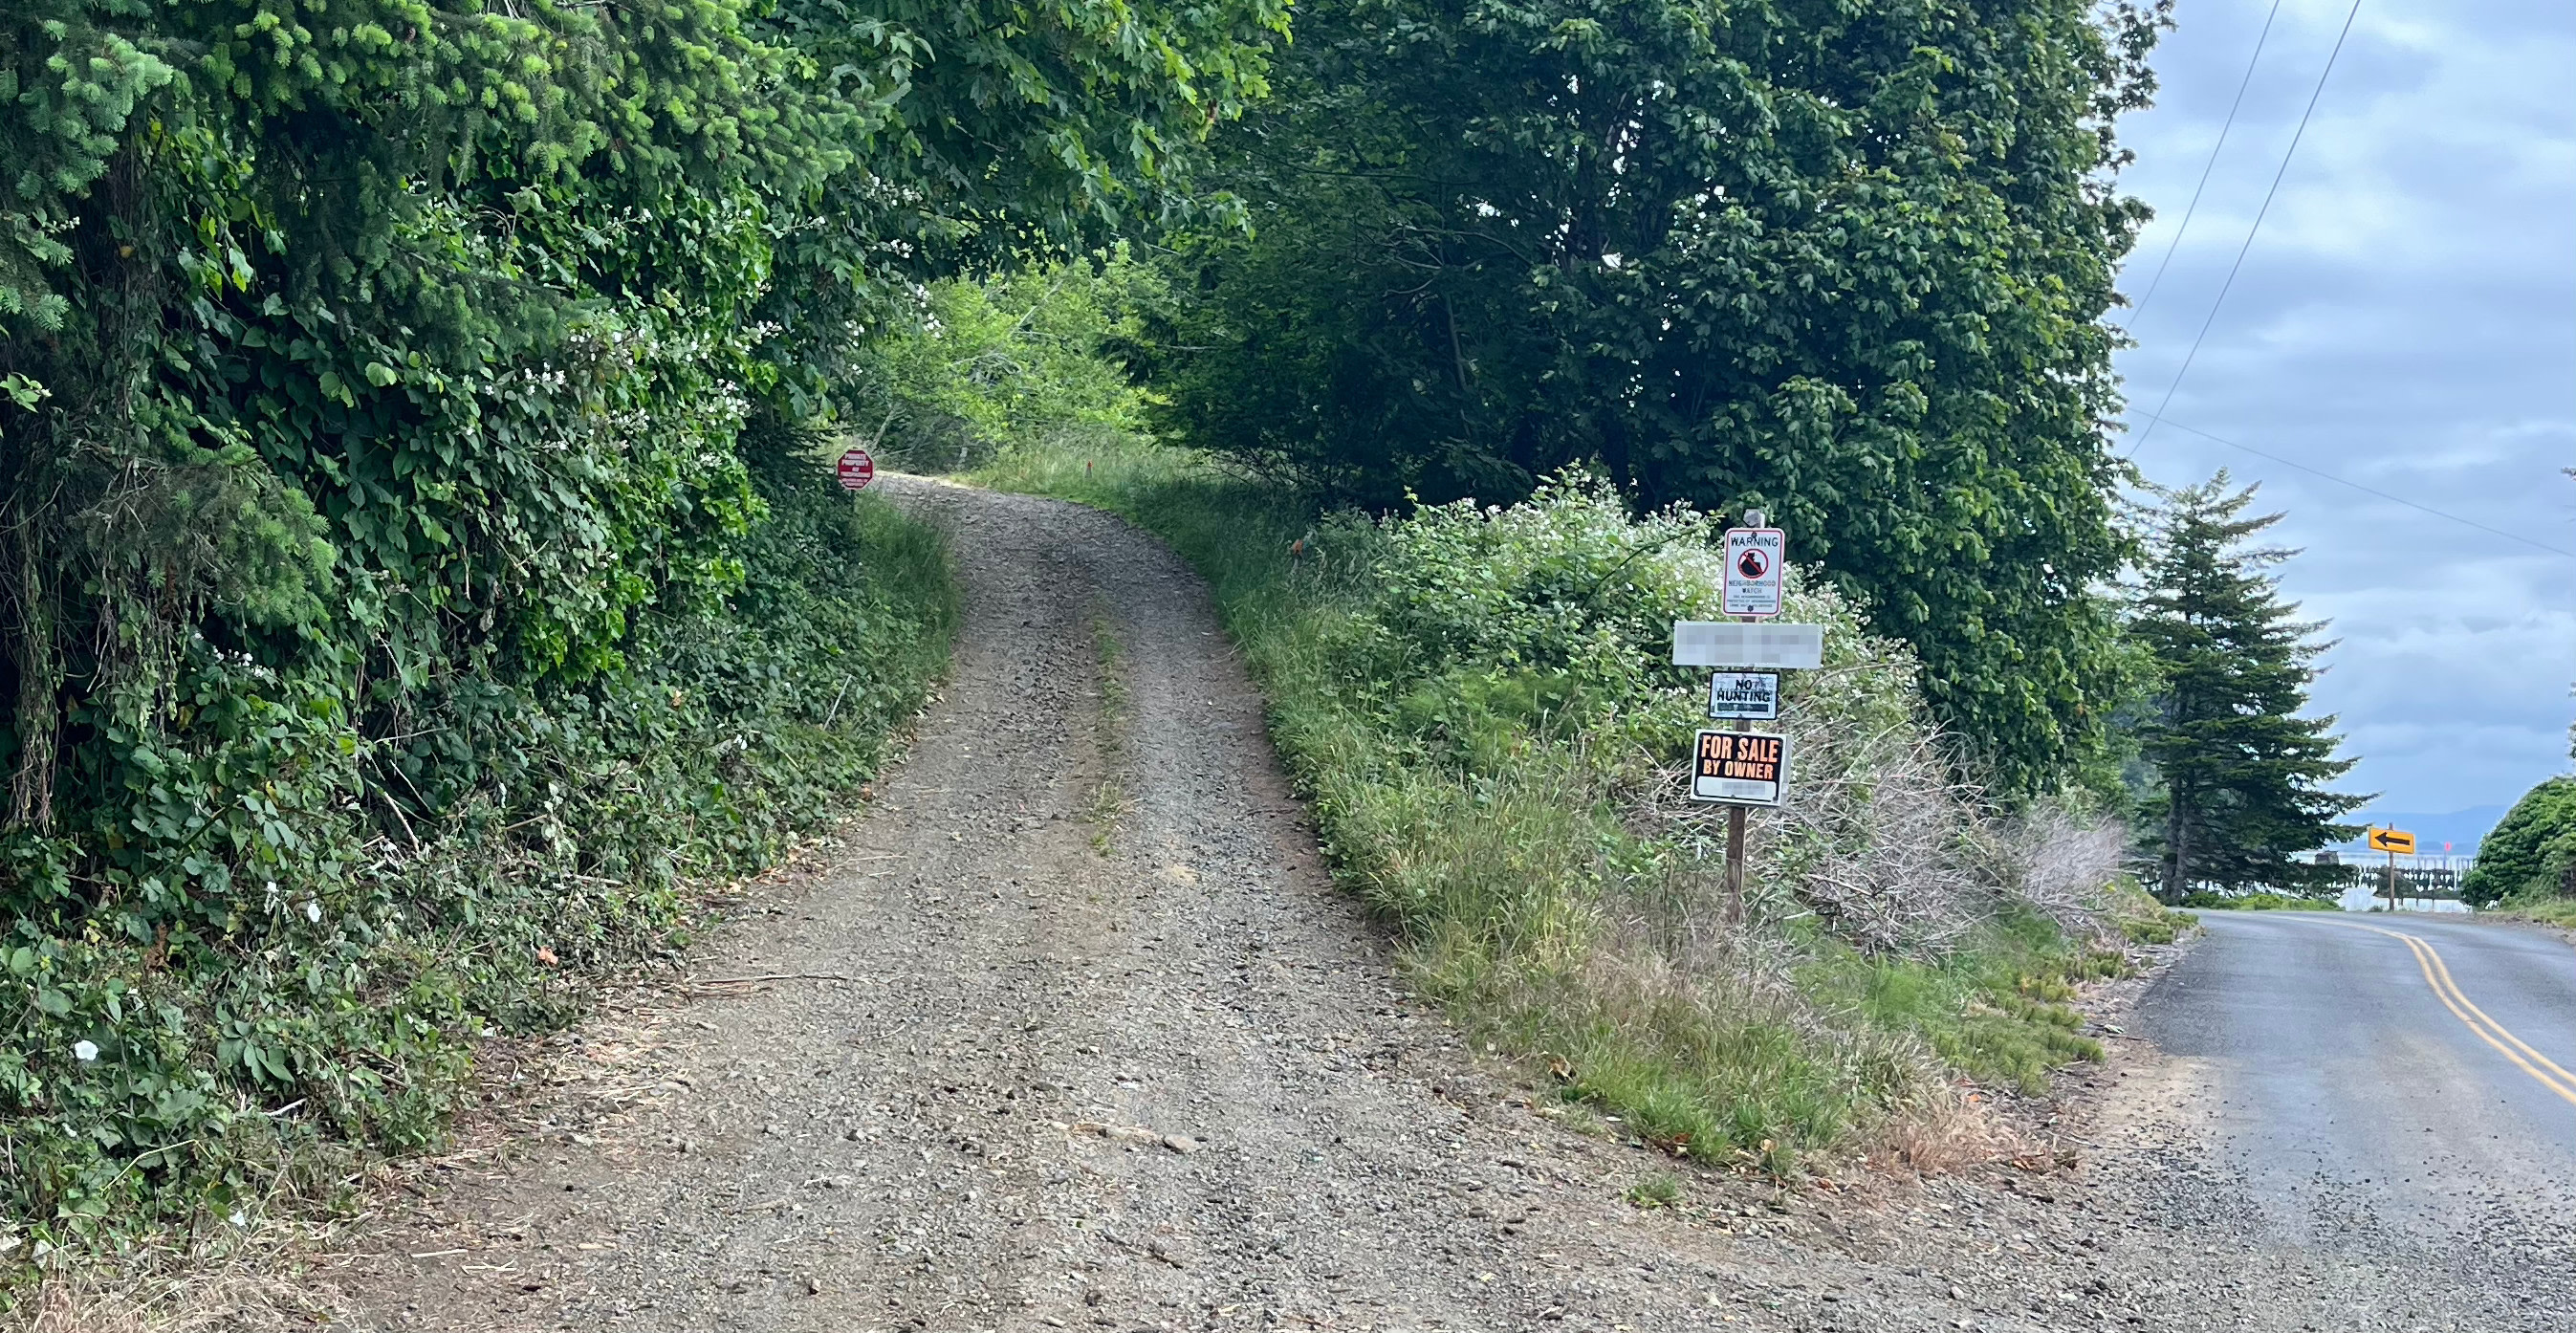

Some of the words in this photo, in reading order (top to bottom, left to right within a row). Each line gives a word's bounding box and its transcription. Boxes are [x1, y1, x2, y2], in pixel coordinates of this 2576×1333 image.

[1731, 536, 1779, 548] WARNING
[1736, 680, 1753, 690] NO
[1716, 690, 1771, 702] HUNTING
[1700, 734, 1733, 759] FOR
[1736, 737, 1779, 763] SALE
[1703, 759, 1721, 776] BY
[1724, 760, 1774, 779] OWNER
